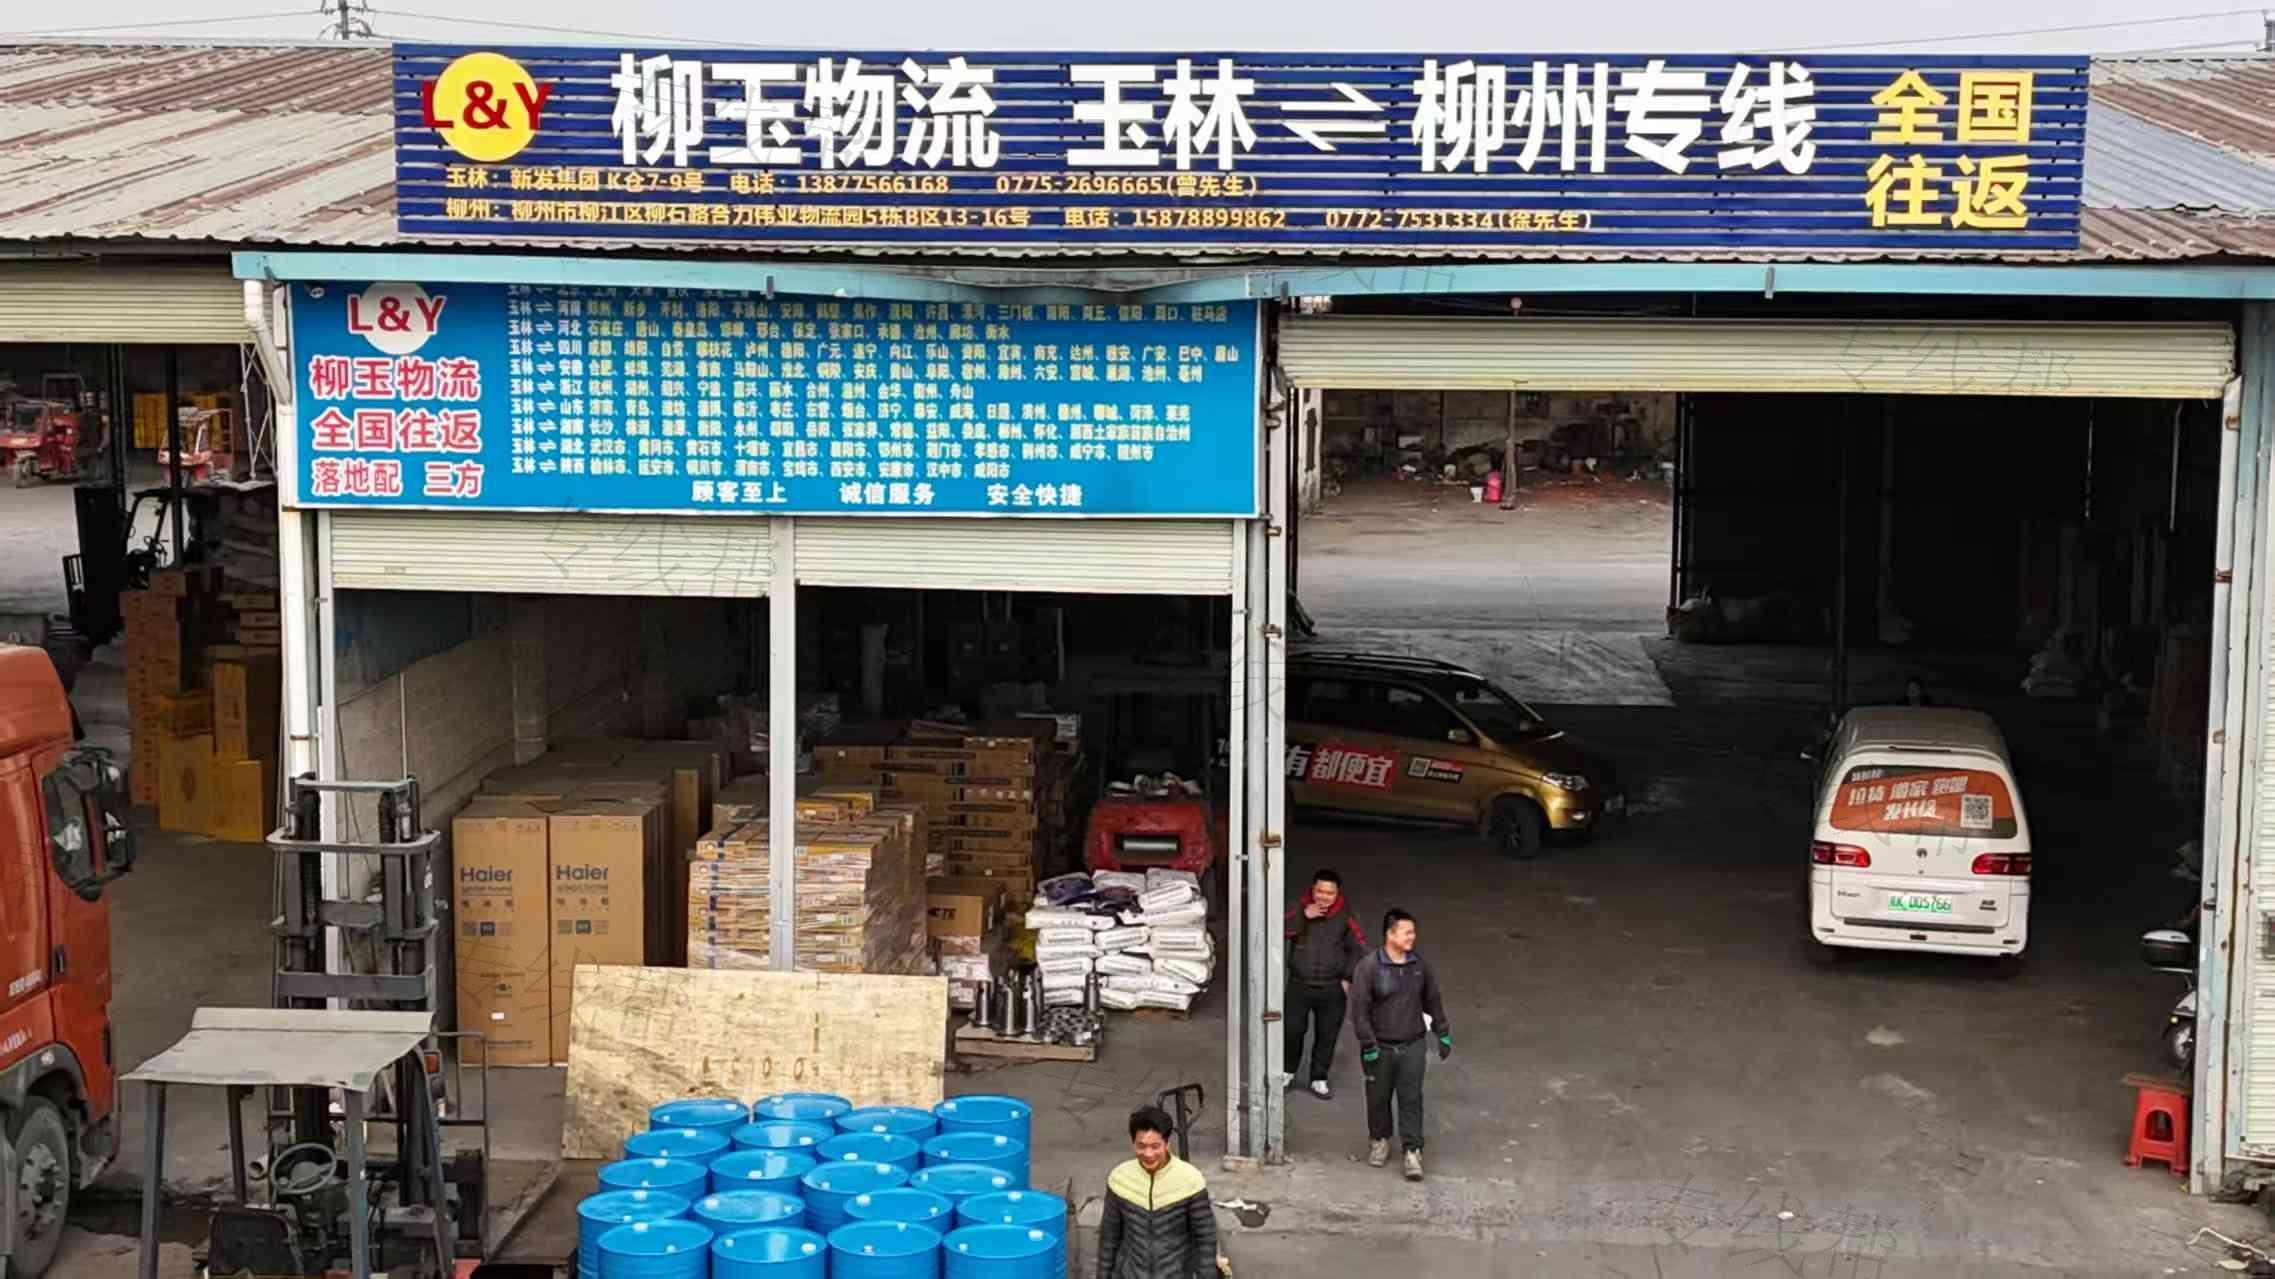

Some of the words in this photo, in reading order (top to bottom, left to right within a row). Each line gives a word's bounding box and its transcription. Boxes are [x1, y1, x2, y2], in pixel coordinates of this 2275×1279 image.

[421, 79, 552, 132] L&Y
[611, 53, 1000, 169] 柳玉物流
[1067, 59, 1257, 171] 玉林
[1411, 60, 1817, 172] 柳州专线
[1870, 71, 2033, 144] 全国
[1865, 153, 2029, 229] 往返
[348, 294, 446, 334] L&Y
[310, 355, 480, 399] 柳玉物流
[311, 408, 482, 452] 全国往返
[312, 457, 403, 497] 落地配
[424, 459, 484, 498] 三方
[692, 480, 787, 504] 顾客至上
[839, 481, 935, 506] 诚信服务
[987, 482, 1083, 507] 安全快捷
[460, 865, 513, 883] Haier
[555, 864, 609, 881] Haier
